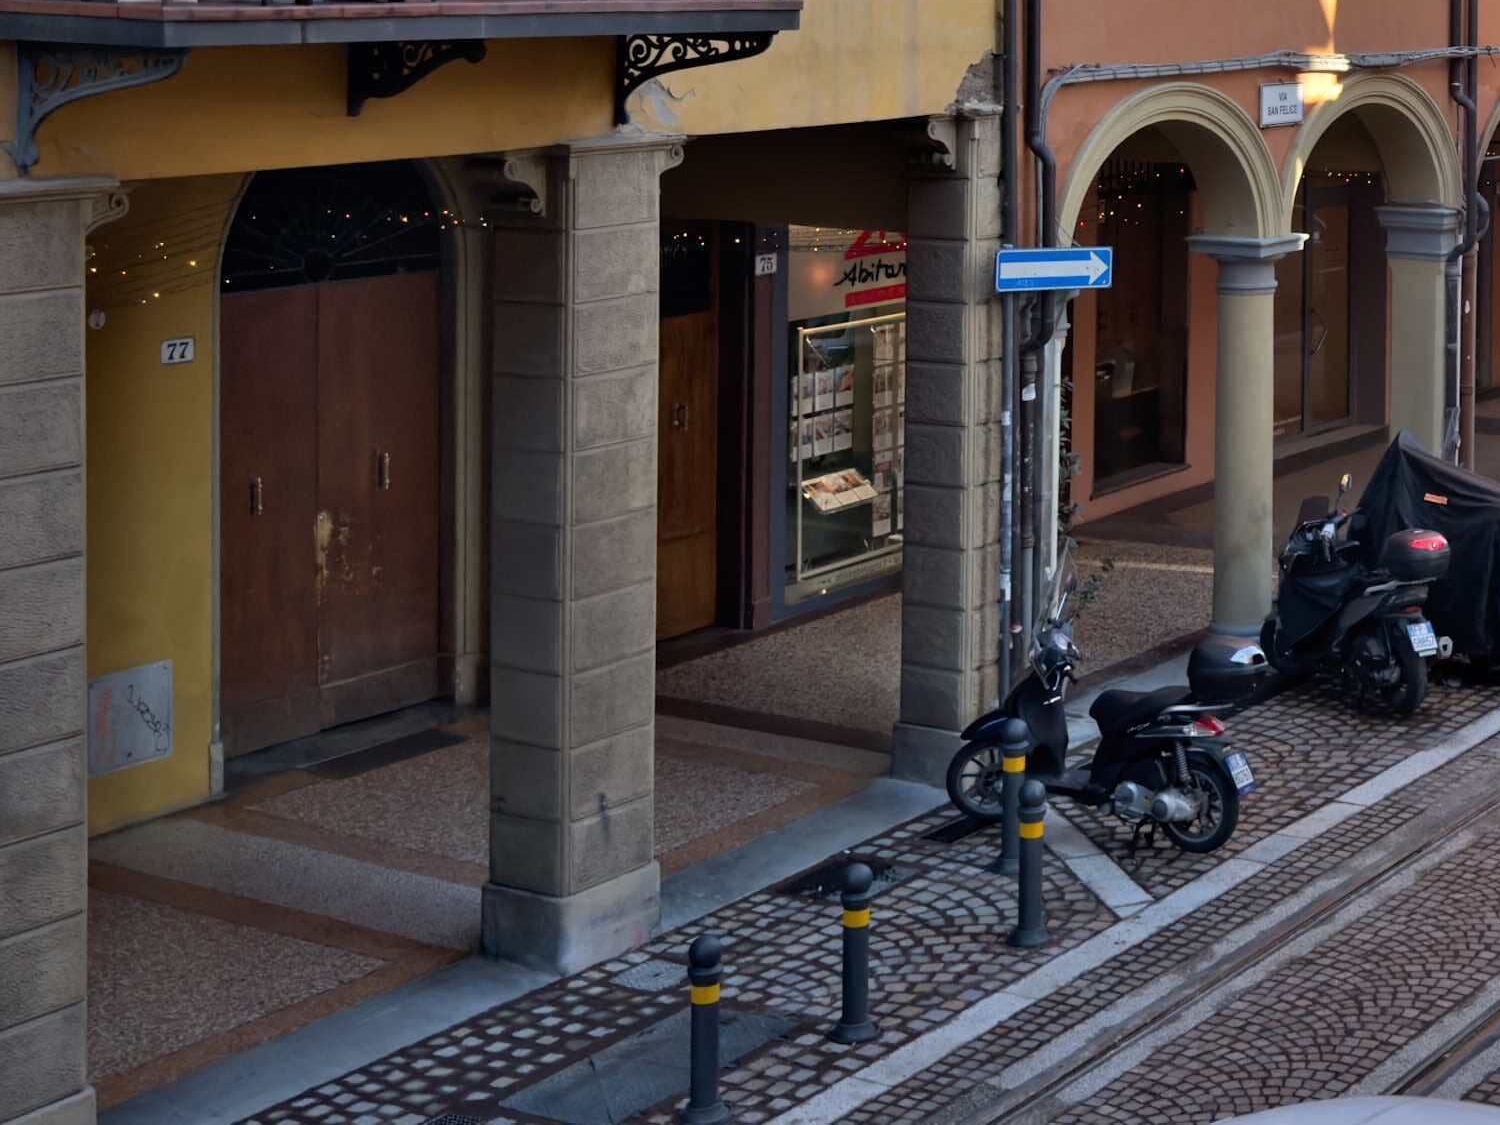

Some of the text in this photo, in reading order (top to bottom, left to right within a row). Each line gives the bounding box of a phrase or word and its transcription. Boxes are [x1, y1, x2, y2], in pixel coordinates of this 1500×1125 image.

[1278, 91, 1287, 101] VIA
[1267, 104, 1298, 116] SAN FELICE
[759, 257, 774, 273] 75
[167, 341, 190, 361] 77
